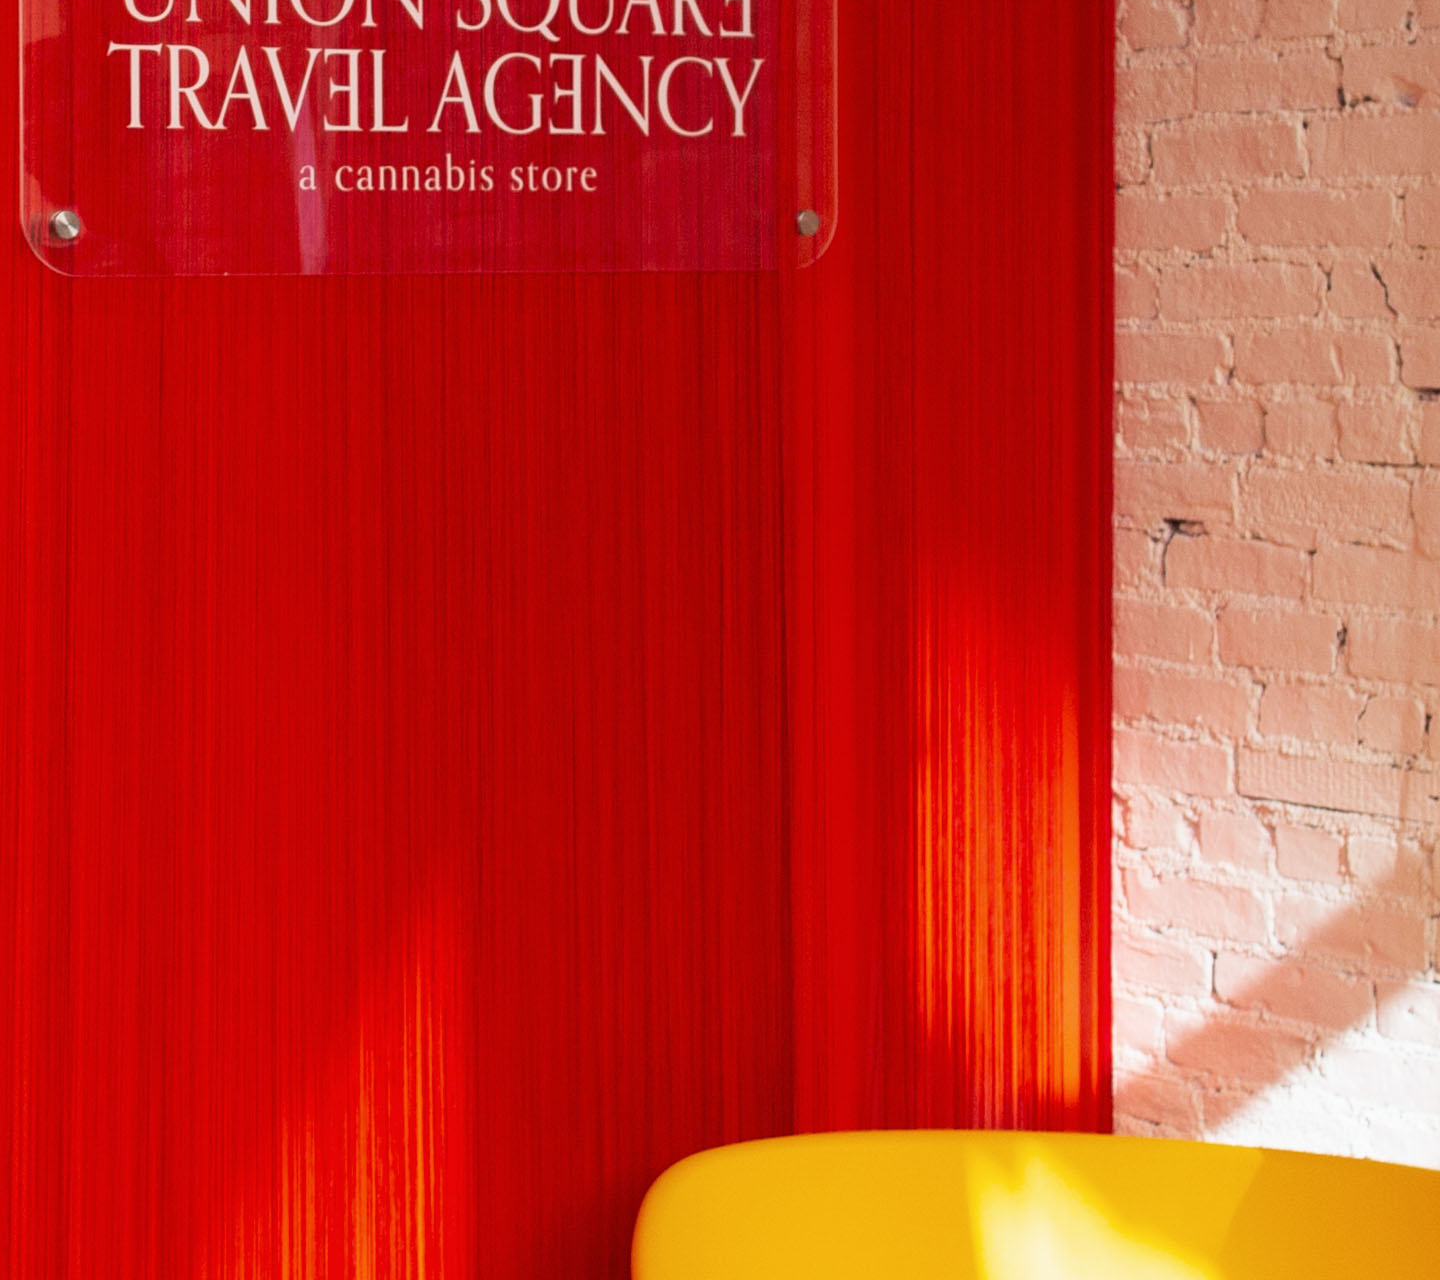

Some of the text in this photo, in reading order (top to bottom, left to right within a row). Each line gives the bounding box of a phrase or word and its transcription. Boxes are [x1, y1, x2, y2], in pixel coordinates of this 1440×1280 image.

[299, 153, 598, 192] a cannabis store
